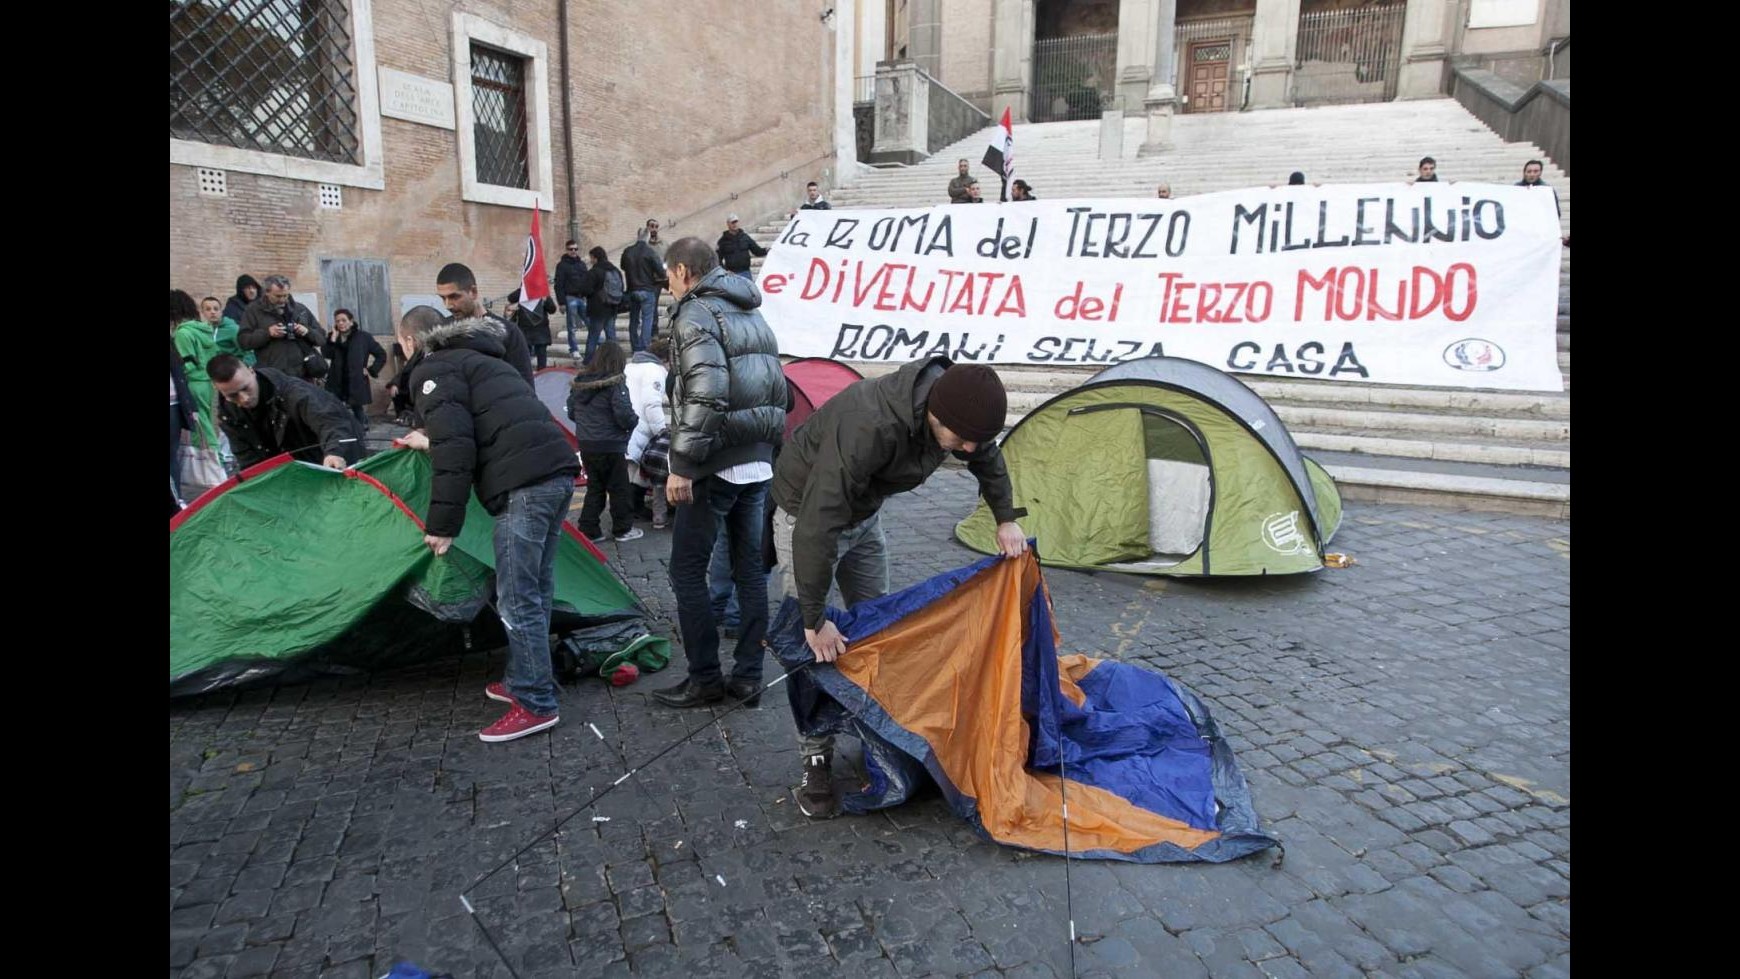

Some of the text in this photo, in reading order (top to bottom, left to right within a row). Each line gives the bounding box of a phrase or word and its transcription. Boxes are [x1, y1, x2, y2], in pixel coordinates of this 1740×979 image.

[781, 220, 811, 248] la
[976, 216, 1038, 259] del
[1066, 207, 1191, 259] TERZO
[1054, 281, 1124, 321] del
[1158, 272, 1274, 323] TERZO
[1294, 262, 1477, 321] MONDO
[1226, 341, 1370, 379] CASA
